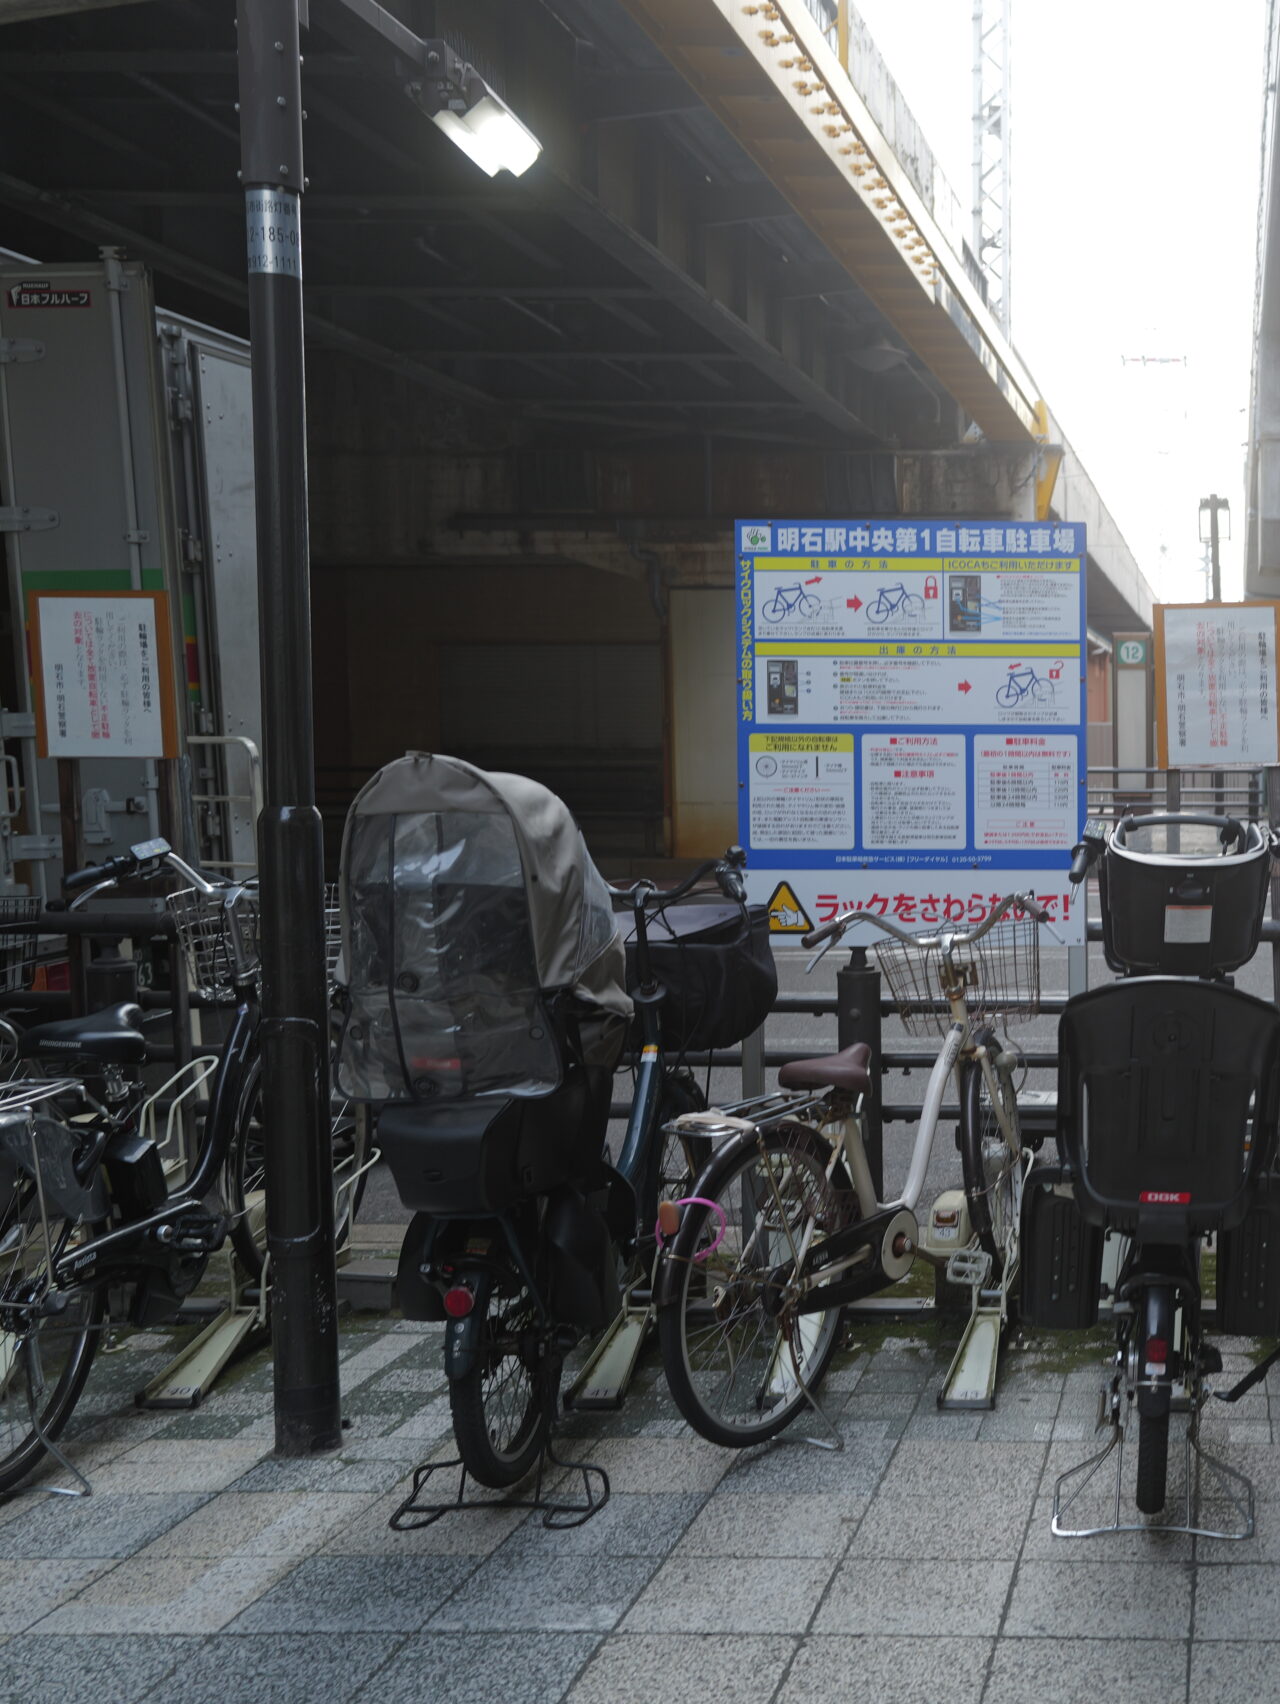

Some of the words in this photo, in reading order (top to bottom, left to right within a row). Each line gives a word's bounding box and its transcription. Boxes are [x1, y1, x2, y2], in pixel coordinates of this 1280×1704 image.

[21, 292, 88, 305] 日本フルハーフ
[777, 527, 1075, 553] 明石駅中央第1自転車駐車場
[810, 559, 888, 569] 駐車の方法
[879, 645, 957, 655] 出庫の方法
[1125, 646, 1139, 659] 12
[1147, 1193, 1180, 1201] OGK
